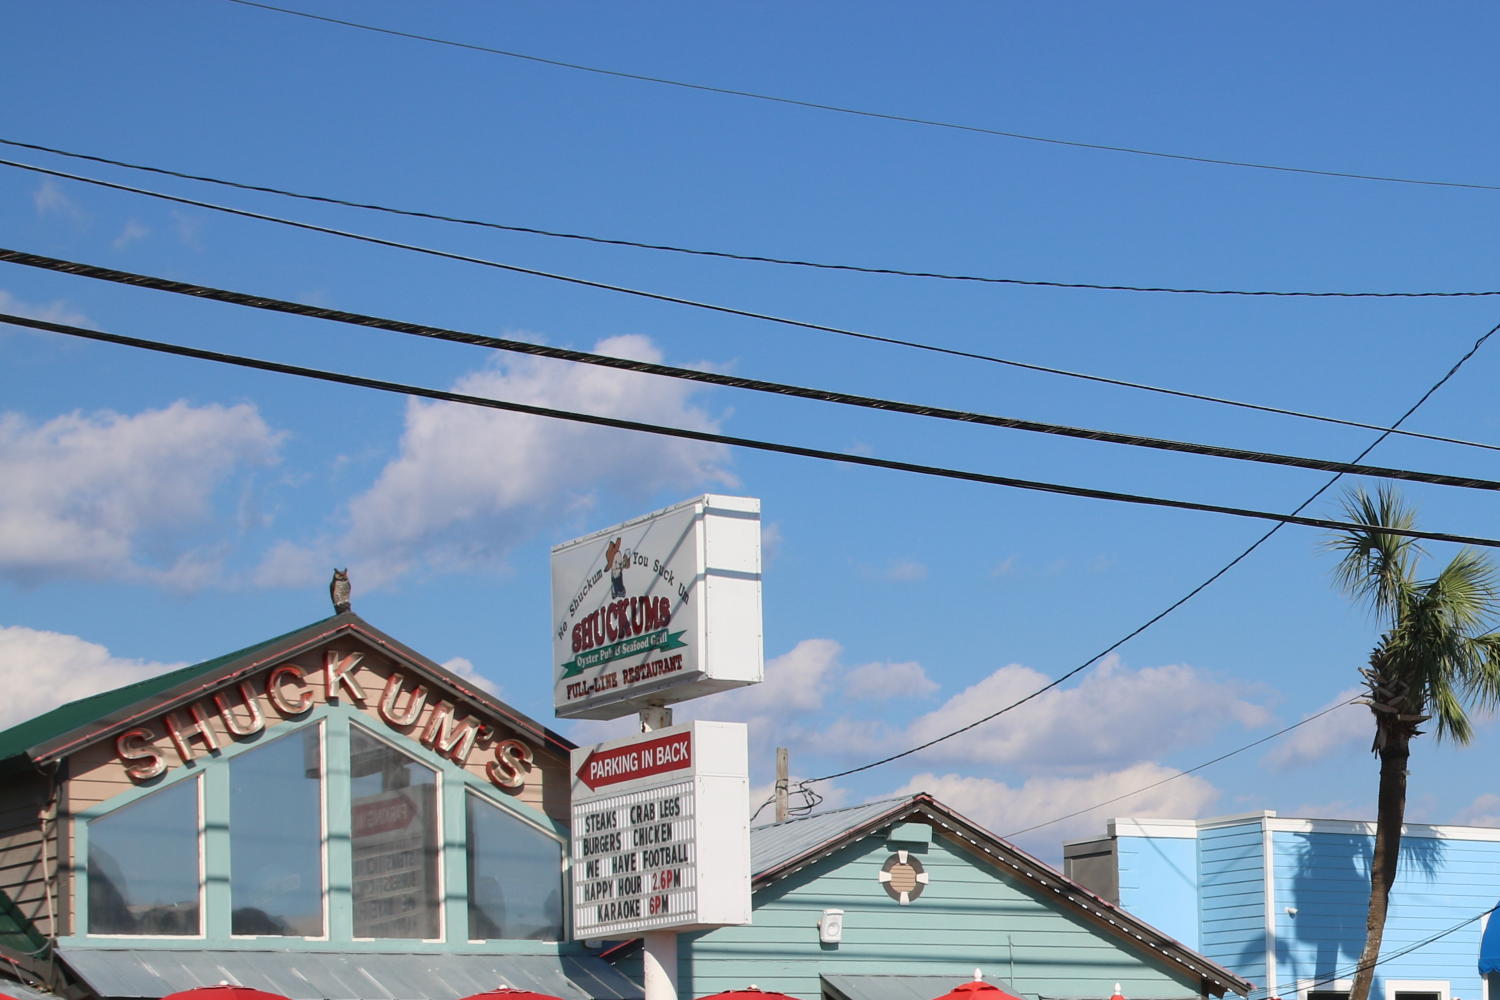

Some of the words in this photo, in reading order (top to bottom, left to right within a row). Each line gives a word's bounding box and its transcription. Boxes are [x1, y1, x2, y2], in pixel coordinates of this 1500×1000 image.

[558, 621, 568, 640] No
[569, 568, 603, 617] Shuckum
[632, 551, 649, 567] You
[652, 559, 675, 586] Suck
[678, 582, 690, 605] Um
[571, 595, 672, 654] SHUCKUMS
[576, 653, 599, 668] Oyster
[600, 647, 614, 661] Pub
[622, 637, 649, 654] Seafood
[650, 631, 668, 648] Grill
[566, 671, 618, 700] FULL-LINE
[622, 654, 683, 685] RESTAURANT
[590, 752, 638, 780] PARKING
[641, 748, 653, 769] IN
[656, 740, 689, 766] BACK
[585, 810, 617, 833] STEAKS
[630, 802, 656, 825] CRAB
[659, 796, 680, 818] LEGS
[583, 832, 622, 856] BURGERS
[633, 822, 672, 847] CHICKEN
[586, 859, 600, 878] WE
[612, 852, 637, 874] HAVE
[643, 843, 688, 869] FOOTBALL
[584, 880, 613, 901] HAPPY
[618, 875, 642, 897] HOUR
[597, 898, 640, 922] KARAOKE
[649, 893, 669, 914] 6PM
